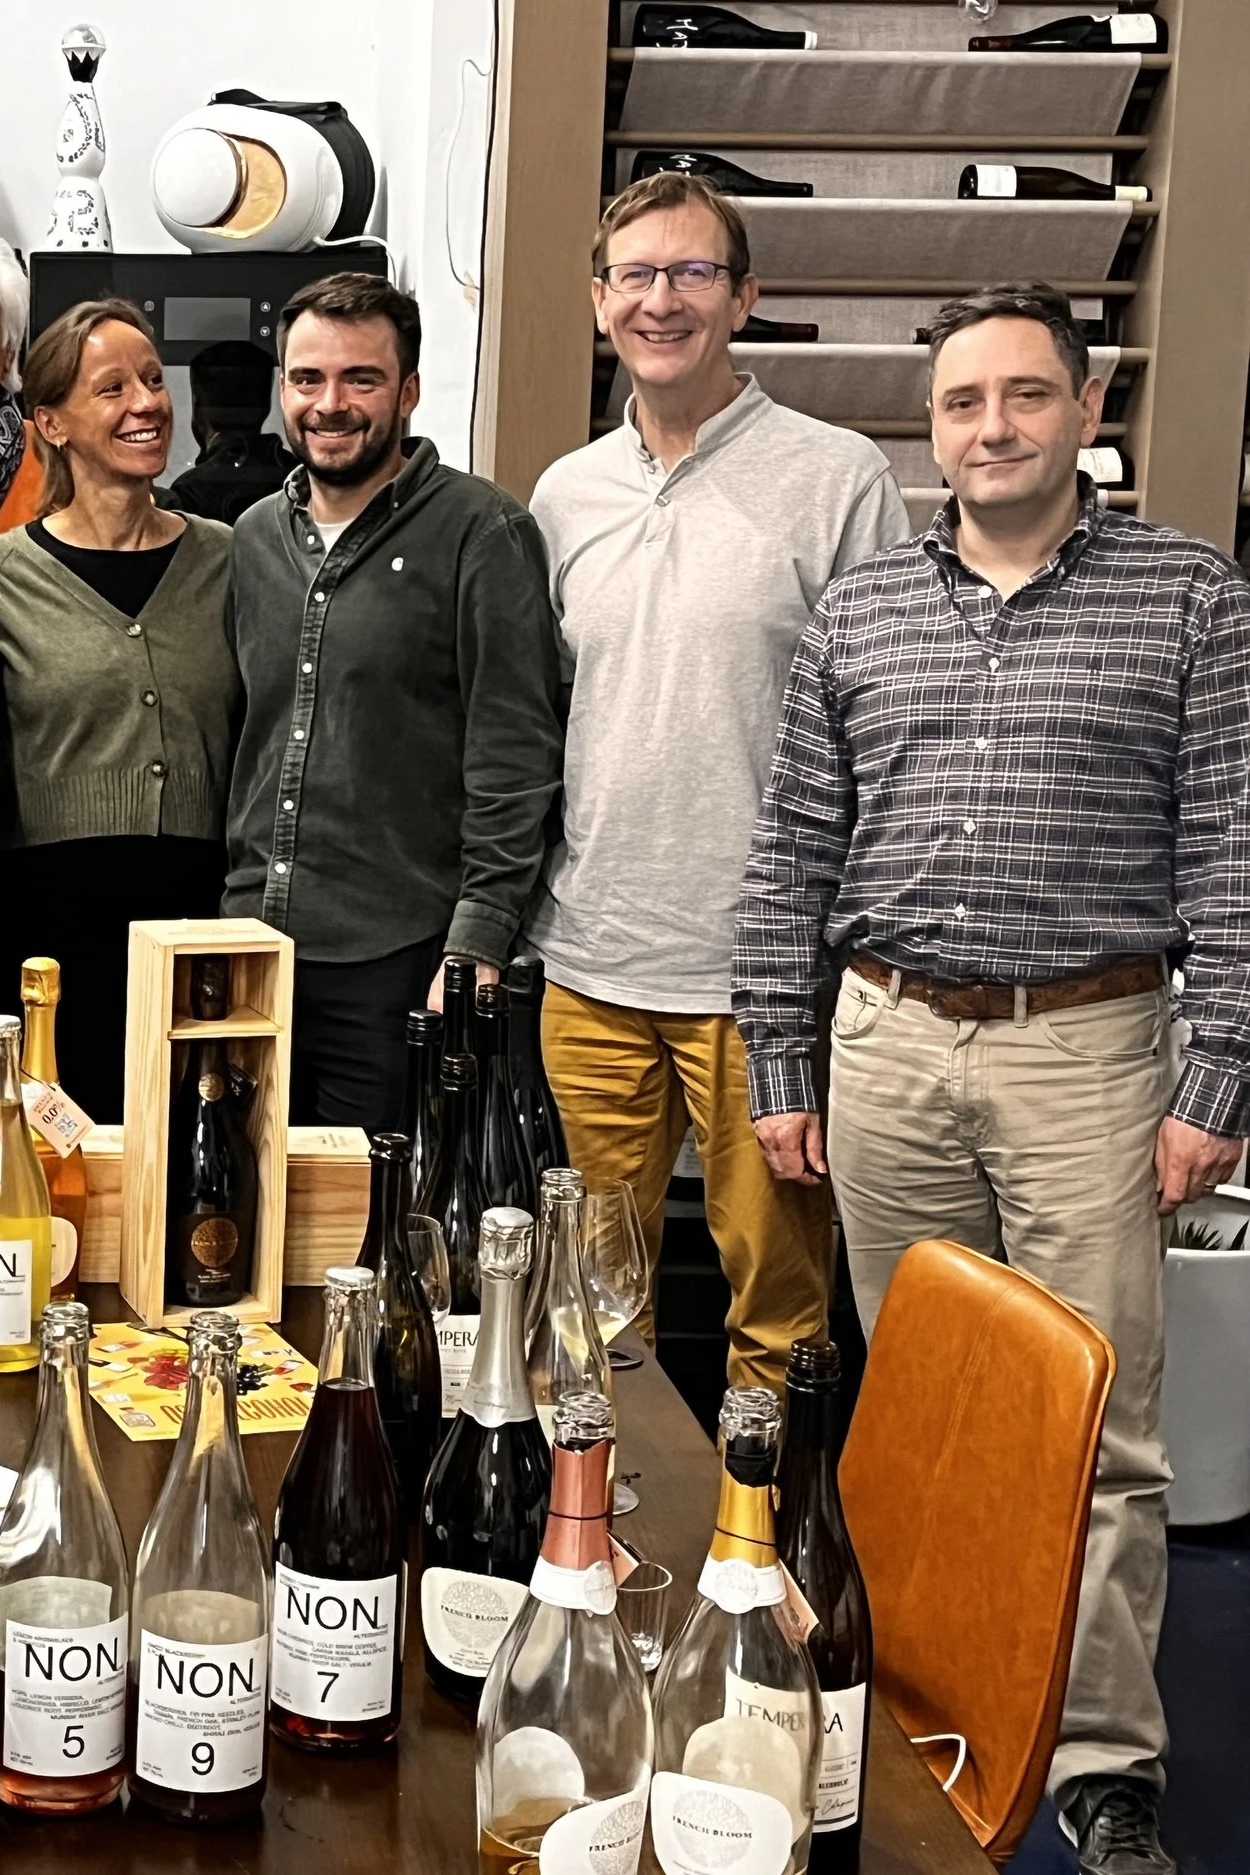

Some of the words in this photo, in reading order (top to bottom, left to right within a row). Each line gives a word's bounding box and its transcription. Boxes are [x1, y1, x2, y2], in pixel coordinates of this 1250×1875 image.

[287, 1586, 379, 1631] NON
[475, 1614, 509, 1622] BLOOM
[25, 1636, 118, 1682] NON
[157, 1653, 254, 1698] NON
[316, 1671, 341, 1703] 7
[61, 1724, 86, 1759] 5
[190, 1741, 215, 1776] 9
[671, 1814, 710, 1835] FRENCH
[712, 1829, 754, 1839] BLOOM
